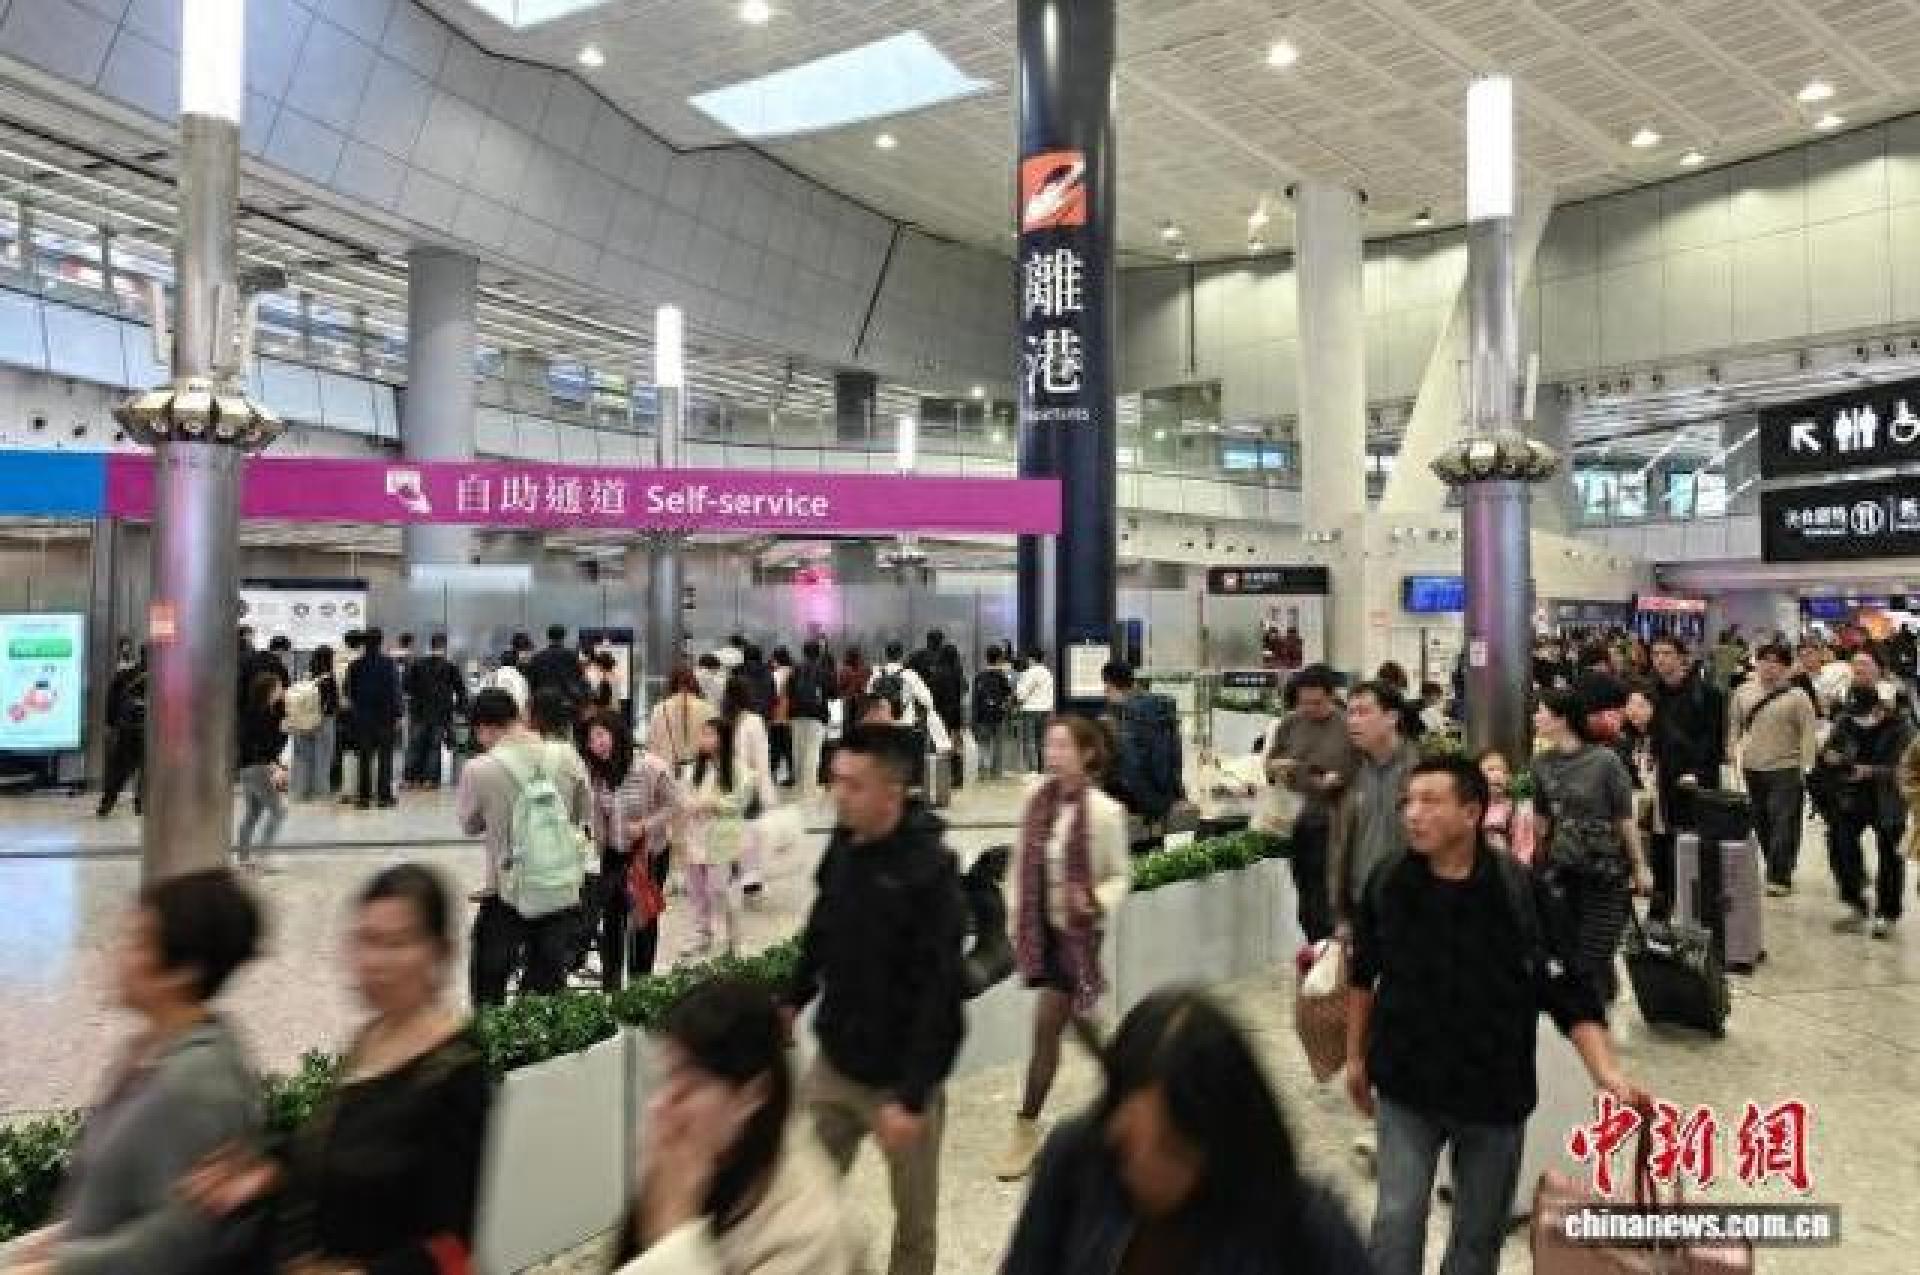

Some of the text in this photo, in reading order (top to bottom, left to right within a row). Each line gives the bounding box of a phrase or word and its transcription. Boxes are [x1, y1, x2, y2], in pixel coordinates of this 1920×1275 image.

[1023, 248, 1085, 394] 離港
[457, 473, 830, 518] 自助通道 Self-service
